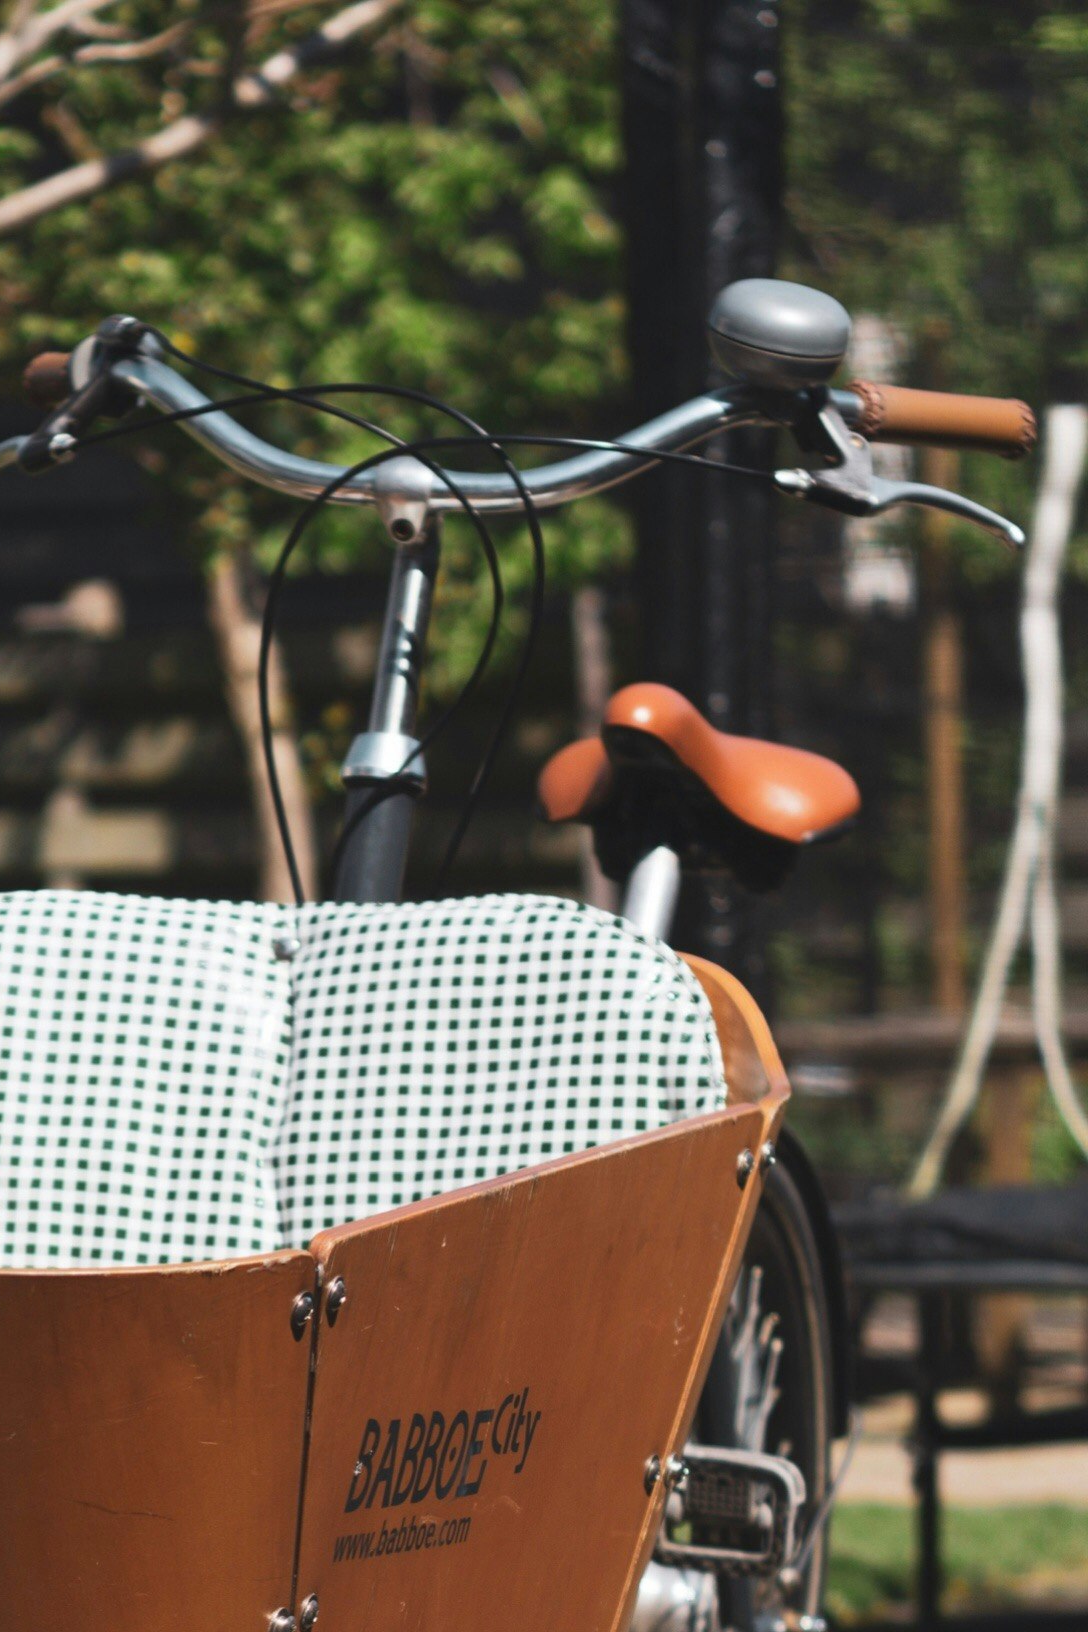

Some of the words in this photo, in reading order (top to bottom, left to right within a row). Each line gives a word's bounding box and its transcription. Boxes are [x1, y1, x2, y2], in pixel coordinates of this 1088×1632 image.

[344, 1409, 495, 1513] BABBOE
[491, 1386, 542, 1474] City
[332, 1515, 472, 1563] www.babboe.com
